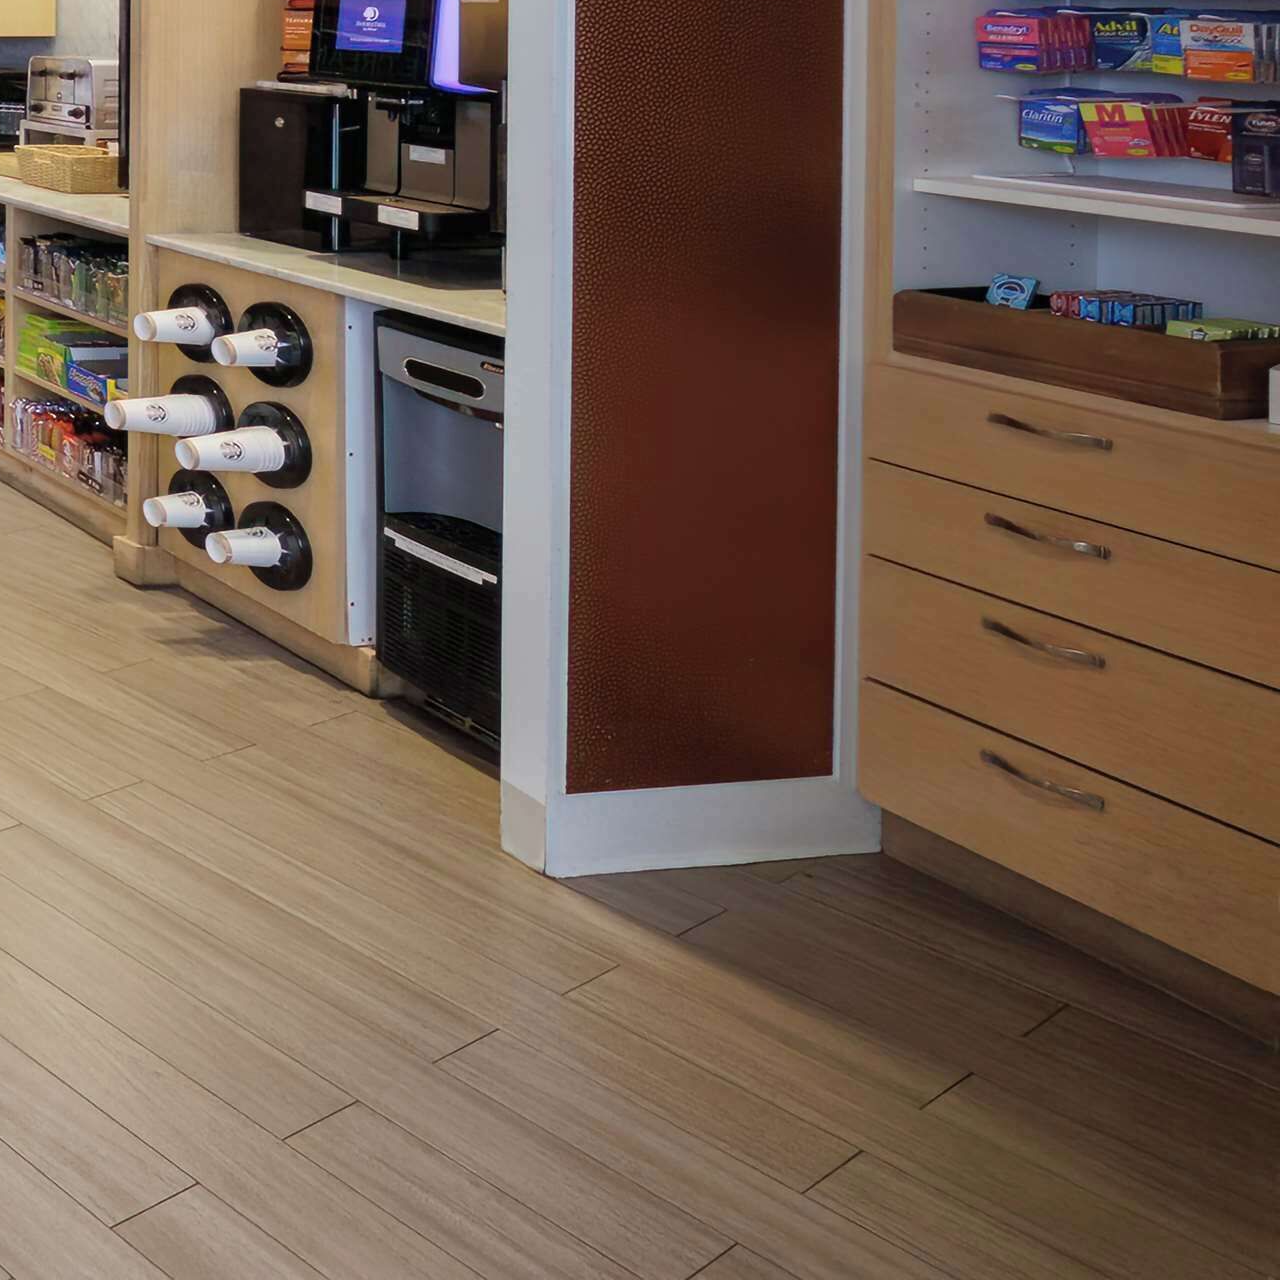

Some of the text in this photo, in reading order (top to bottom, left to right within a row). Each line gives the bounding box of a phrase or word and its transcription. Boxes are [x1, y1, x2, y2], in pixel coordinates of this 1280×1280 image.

[986, 23, 1028, 34] Benadryl
[1094, 20, 1137, 31] Advil
[1190, 24, 1244, 35] DayQuil
[1022, 109, 1063, 123] Claritin
[1188, 109, 1232, 124] TYLEN
